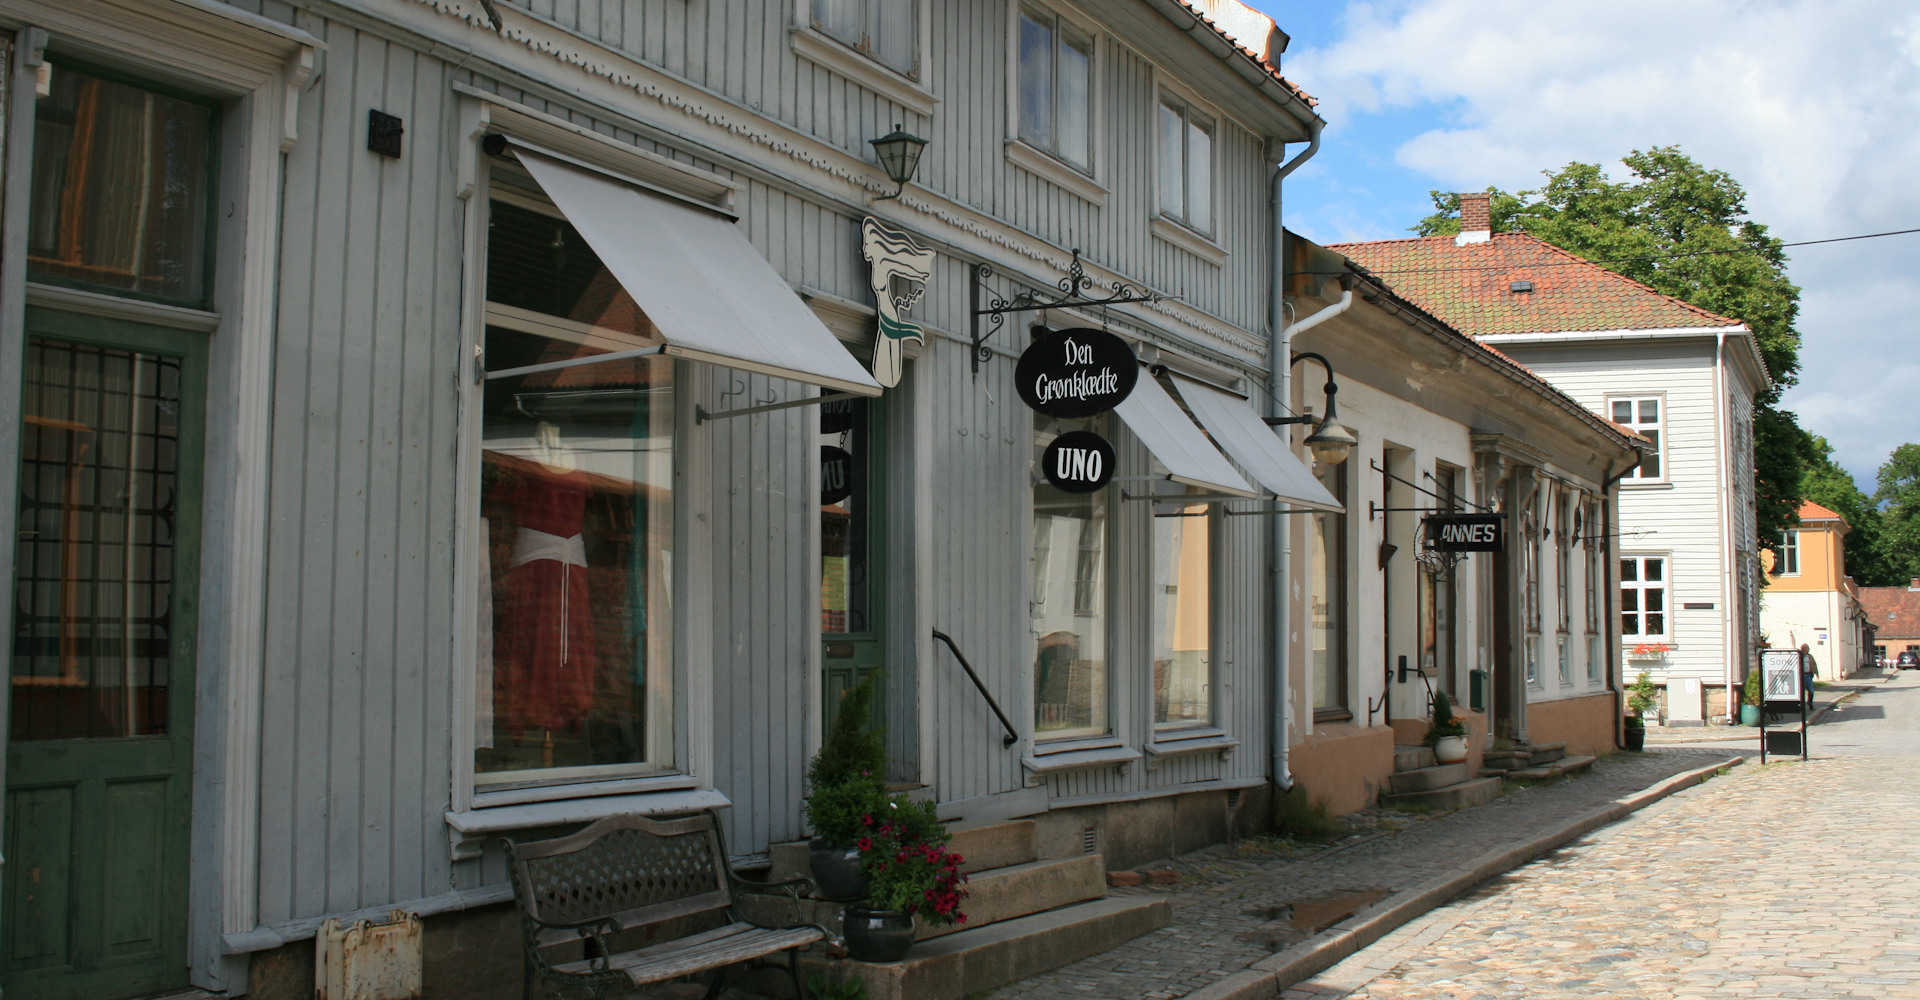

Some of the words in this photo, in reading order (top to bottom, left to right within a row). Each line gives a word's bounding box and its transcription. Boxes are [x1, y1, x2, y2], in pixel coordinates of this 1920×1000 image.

[1064, 336, 1095, 367] Den
[1035, 366, 1119, 405] Grønklædte
[1057, 447, 1103, 483] UNO
